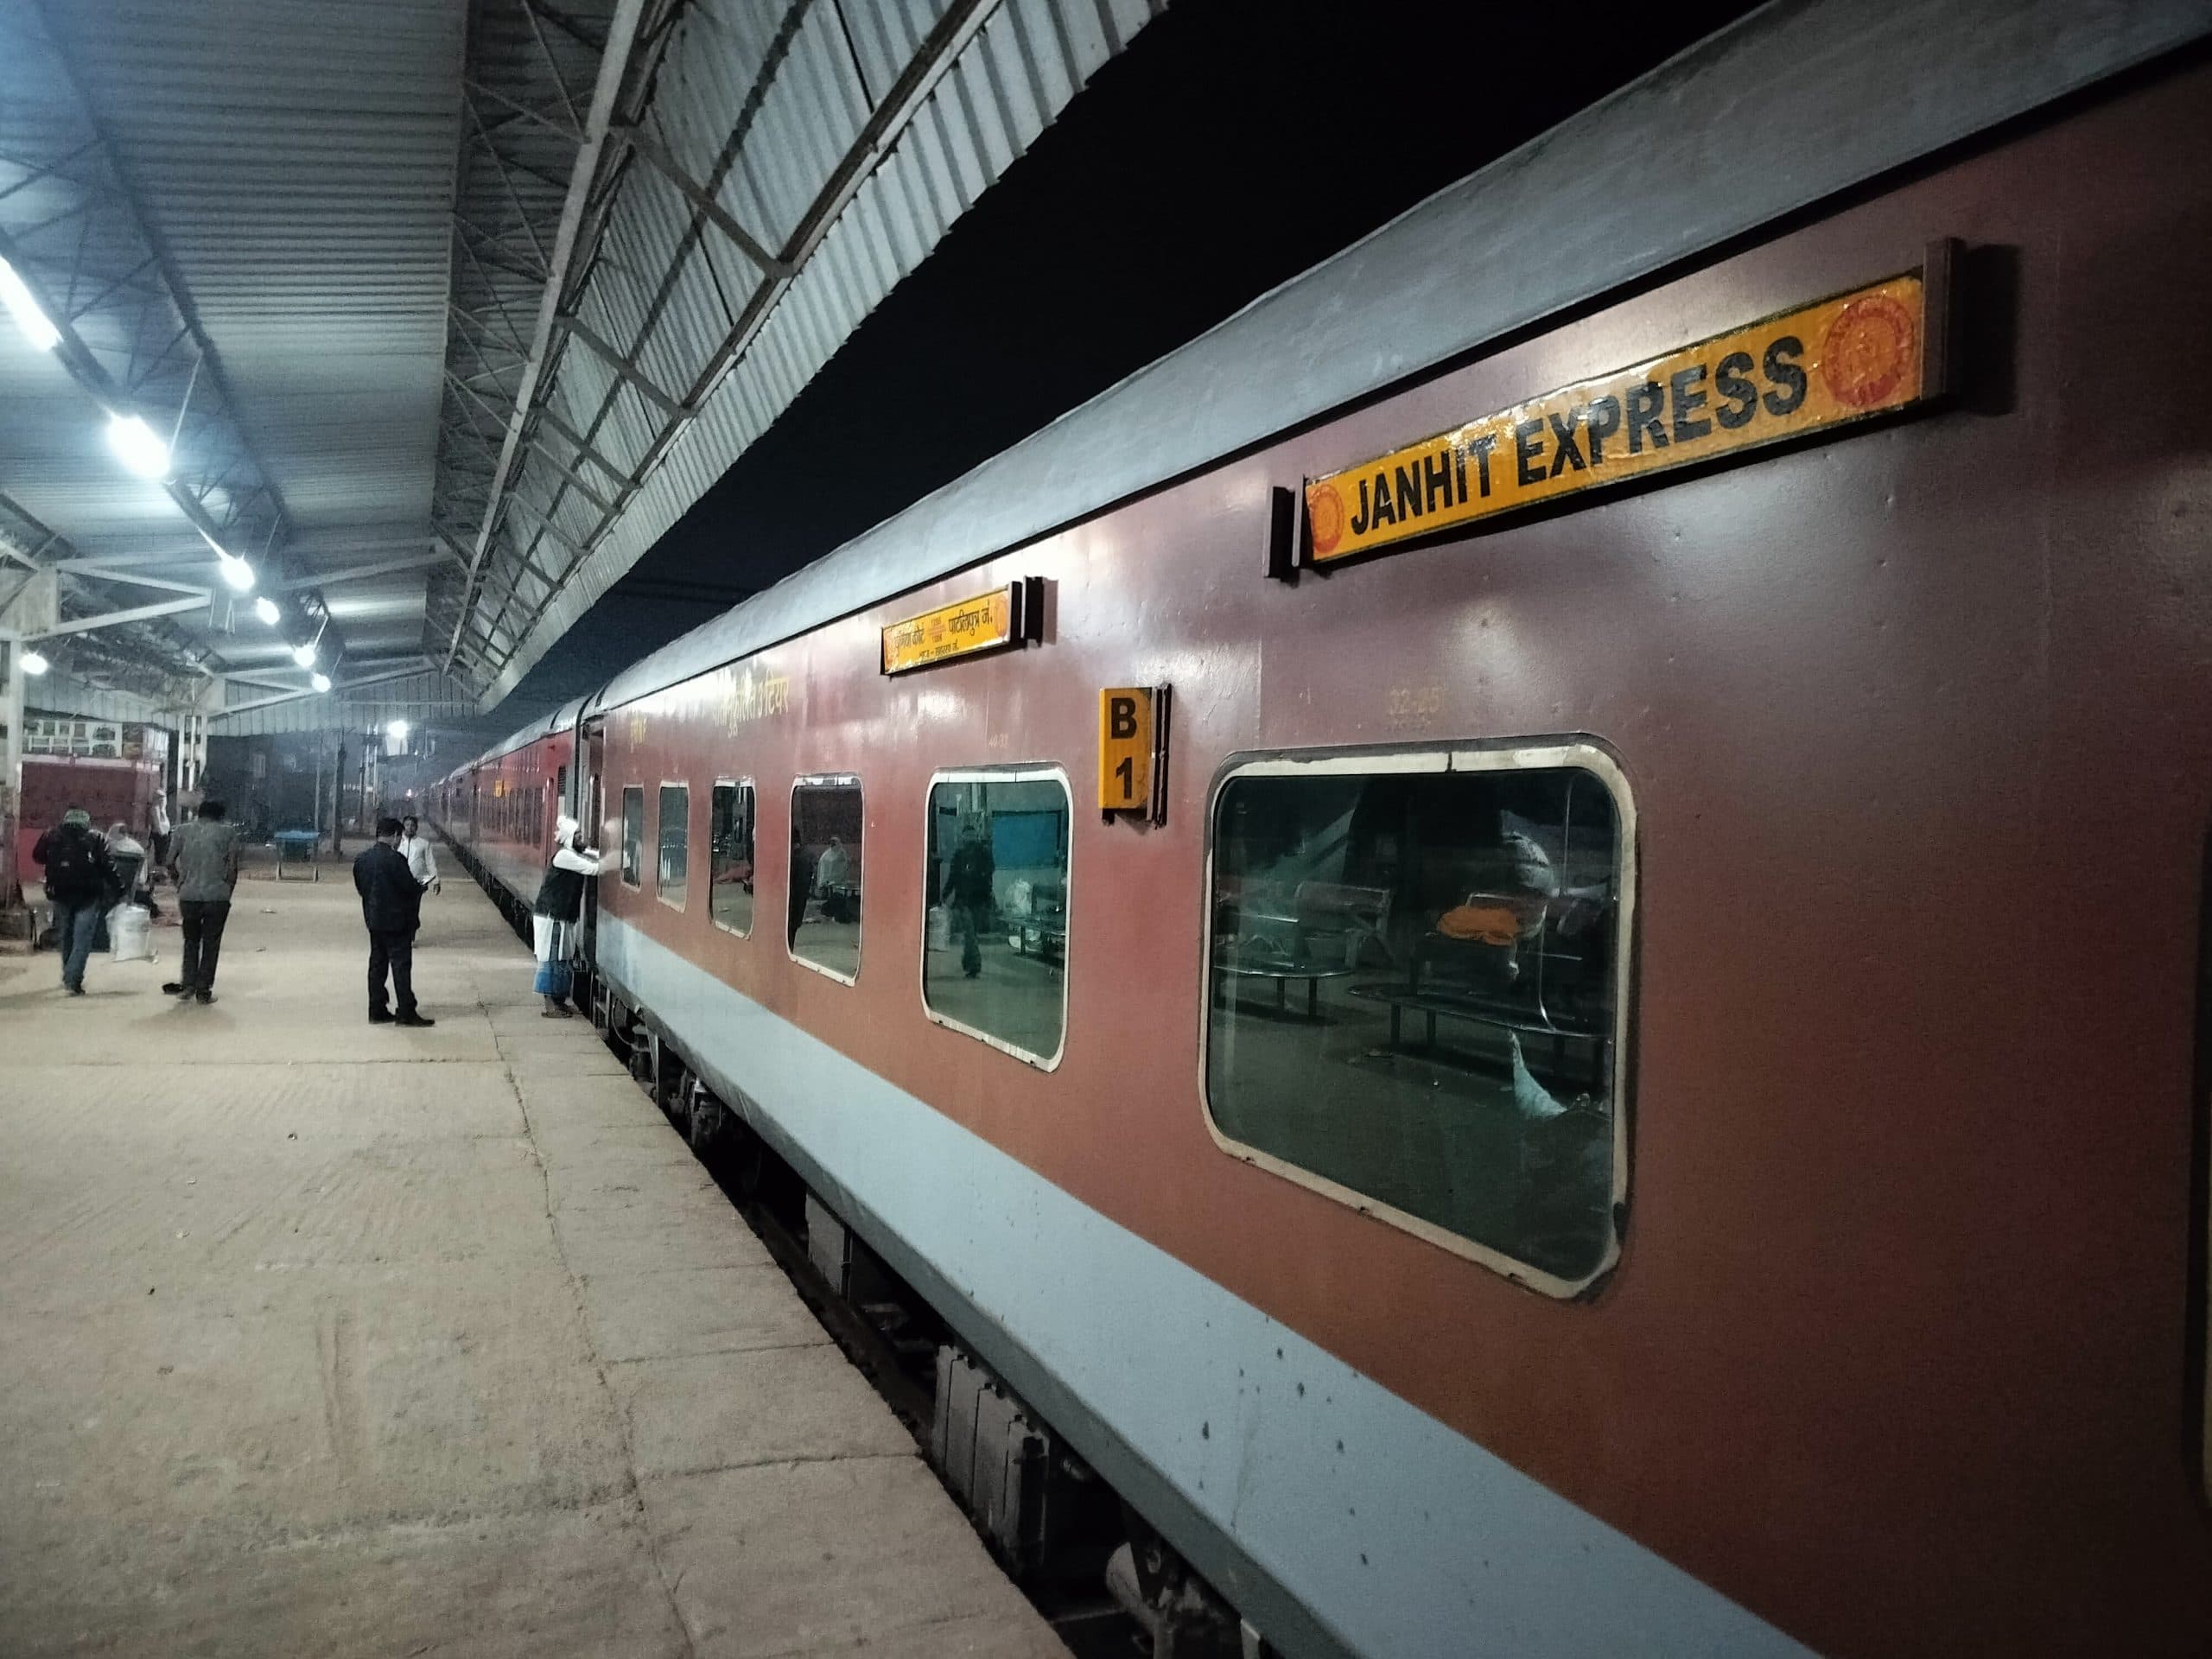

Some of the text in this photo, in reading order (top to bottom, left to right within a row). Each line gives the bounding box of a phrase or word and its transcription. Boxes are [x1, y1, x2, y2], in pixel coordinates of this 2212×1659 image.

[1351, 435, 1497, 536] JANHIT
[1516, 335, 1808, 487] EXPRESS
[1111, 697, 1137, 740] B
[1116, 757, 1133, 799] 1
